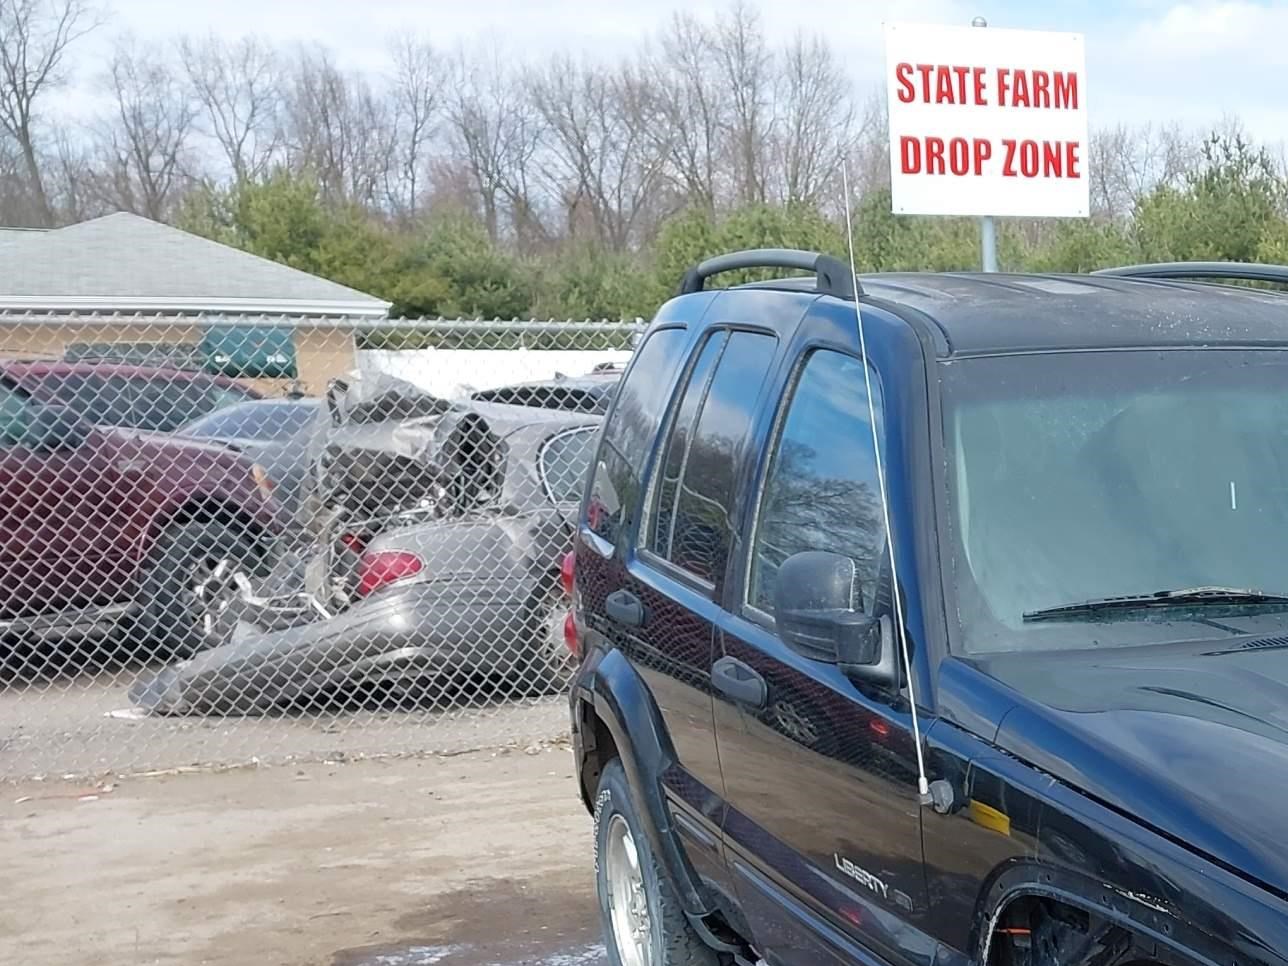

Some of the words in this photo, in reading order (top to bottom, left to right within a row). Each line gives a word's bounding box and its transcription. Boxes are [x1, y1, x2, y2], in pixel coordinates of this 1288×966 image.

[896, 62, 988, 106] STATE
[997, 68, 1079, 110] FARM
[900, 135, 992, 176] DROP
[1001, 138, 1081, 179] ZONE
[833, 852, 888, 899] LIBERTY
